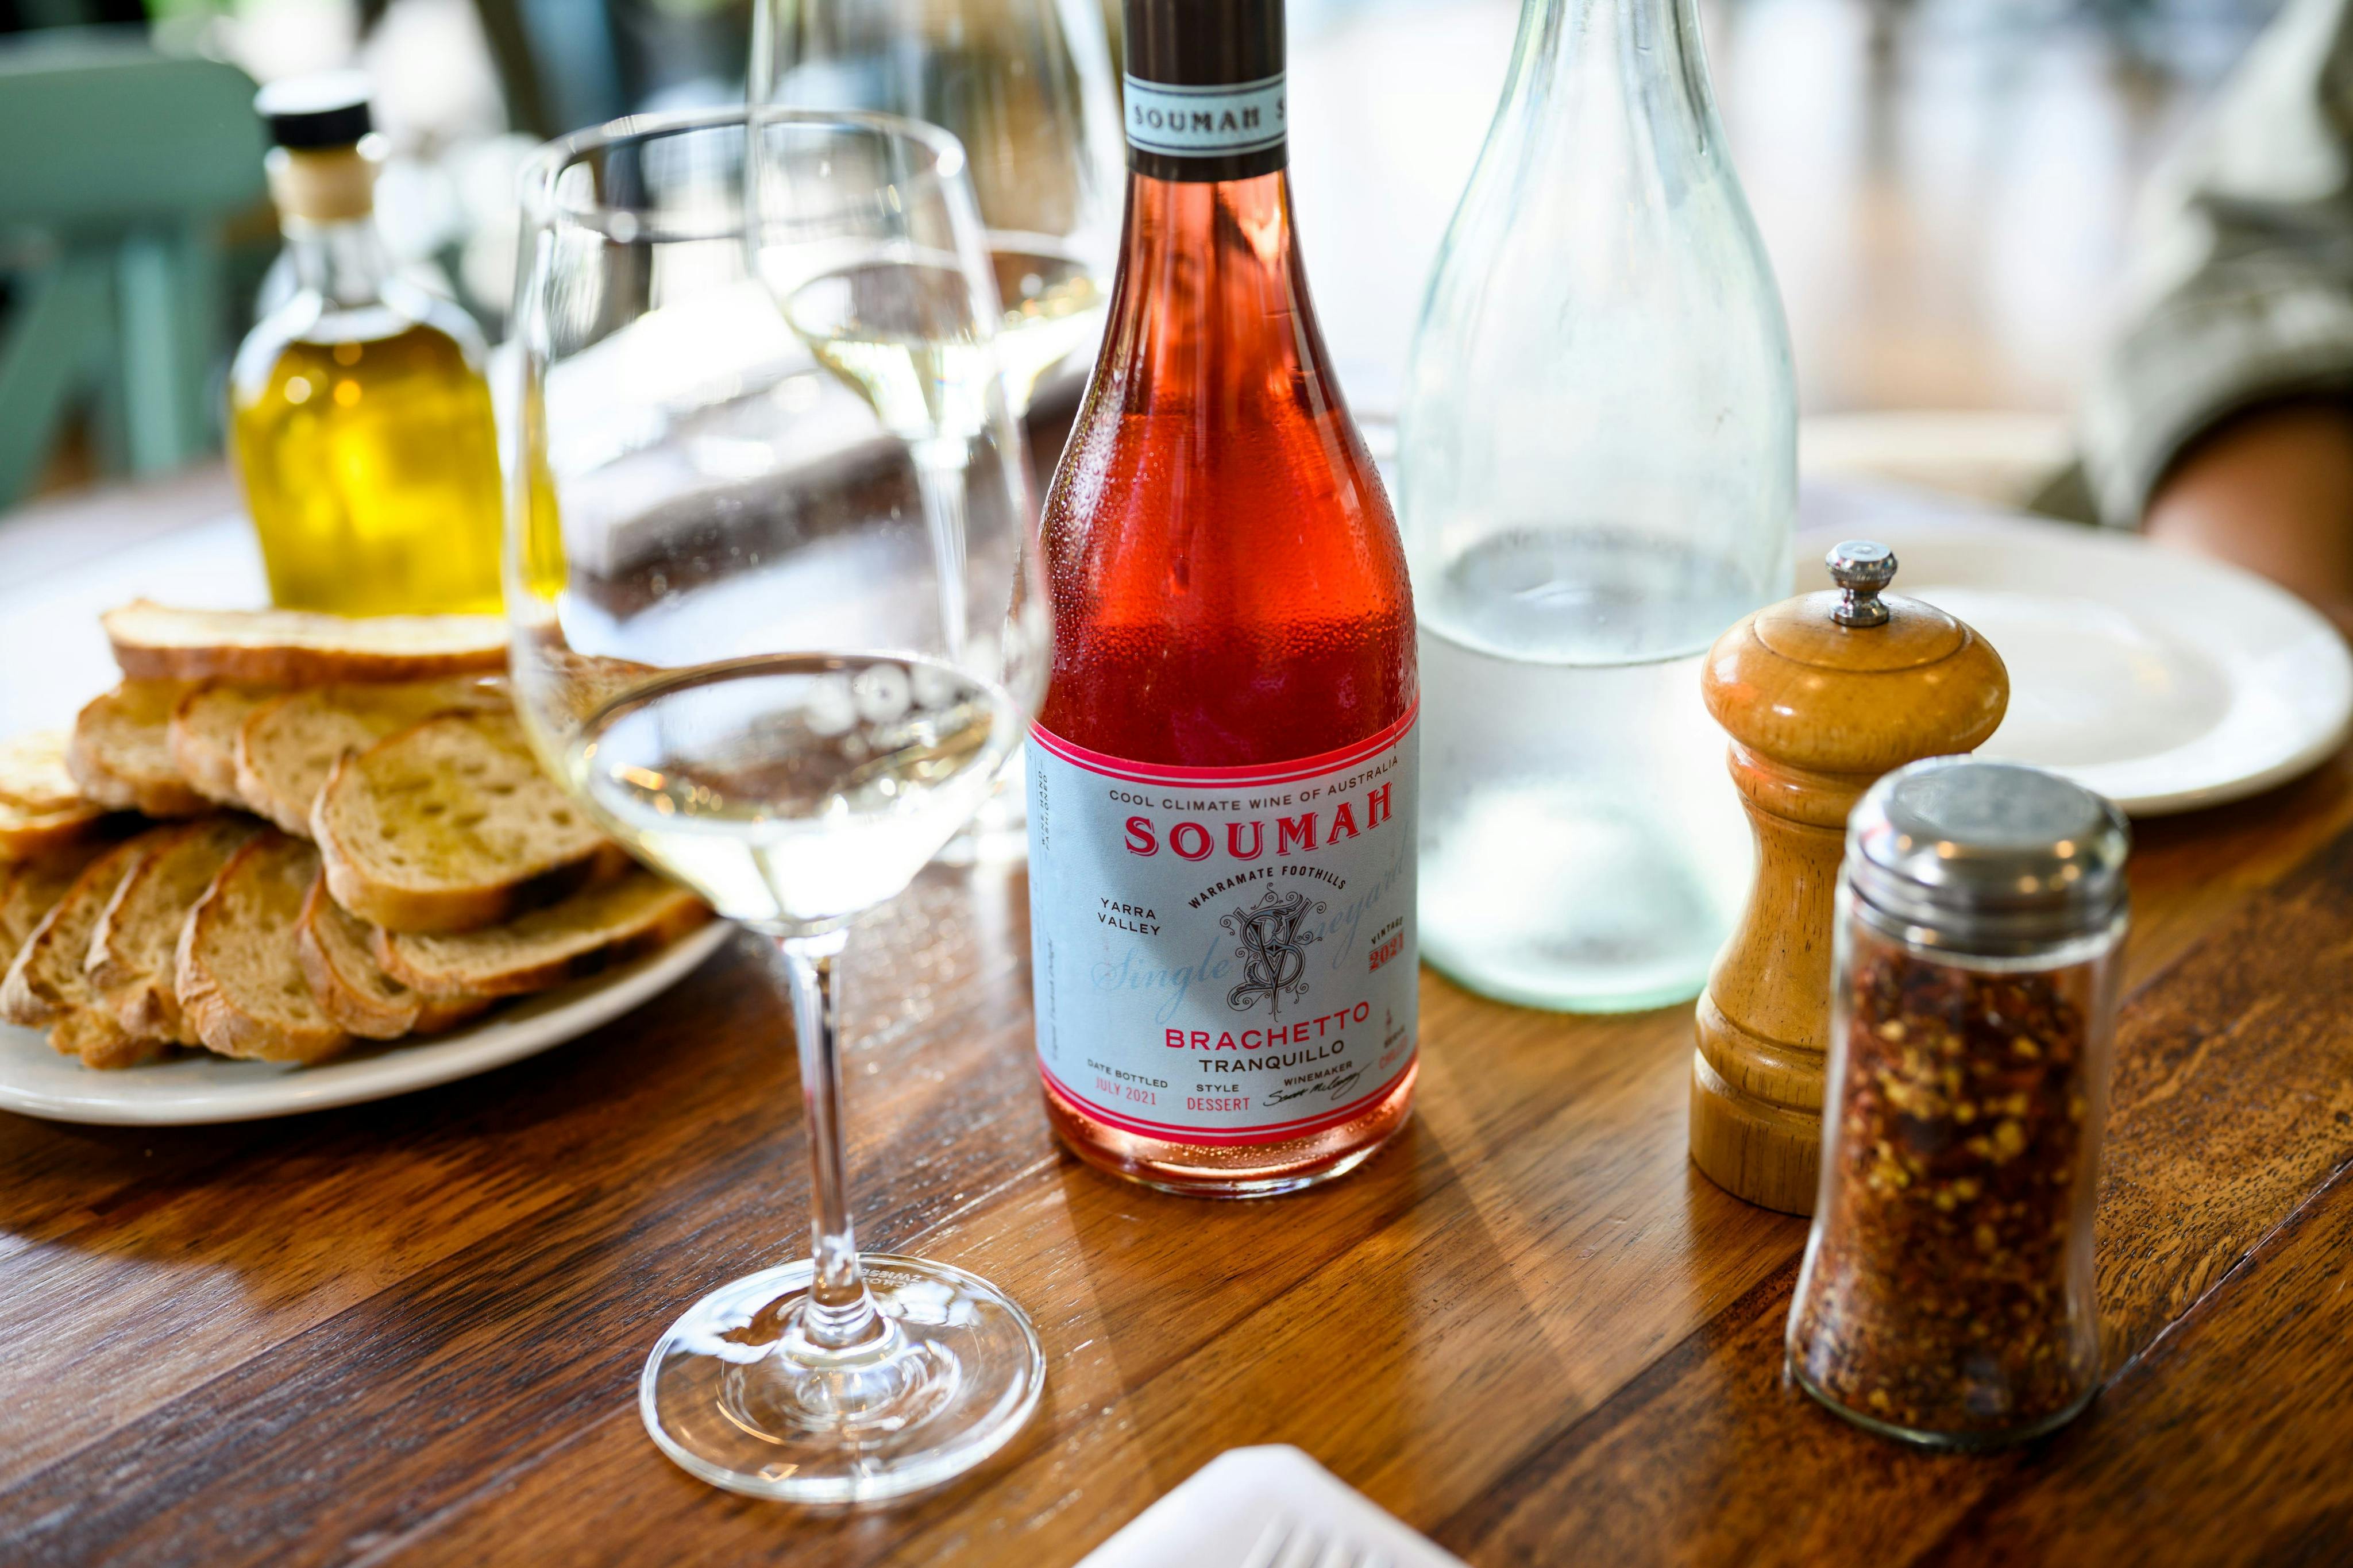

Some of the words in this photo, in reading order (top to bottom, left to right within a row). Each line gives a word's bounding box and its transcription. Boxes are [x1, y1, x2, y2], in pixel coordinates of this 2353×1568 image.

[1133, 105, 1261, 133] SOUMAH
[1109, 790, 1154, 807] COOL
[1162, 798, 1241, 811] CLIMATE
[1249, 794, 1291, 809] WINE
[1299, 788, 1321, 801] OF
[1328, 755, 1398, 795] AUSTRALIA
[1124, 781, 1392, 862] SOUMAH
[1187, 867, 1274, 910] WARRAMATE
[1282, 865, 1347, 890] FOOTHILLS
[1101, 897, 1156, 920] YARRA
[1098, 912, 1161, 936] VALLEY
[1371, 916, 1403, 945] VINTAGE
[1368, 930, 1404, 971] 2021
[1090, 934, 1233, 1025] Single
[1165, 1001, 1370, 1051] BRACHETTO
[1199, 1040, 1344, 1073] TRANQUILLO
[1087, 1058, 1112, 1075] DATE
[1115, 1069, 1168, 1088] BOTTLED
[1196, 1084, 1239, 1092] STYLE
[1283, 1061, 1352, 1087] WINEMAKER
[1095, 1076, 1121, 1096] JULY
[1126, 1086, 1156, 1106] 2021
[1187, 1097, 1250, 1111] DESSERT
